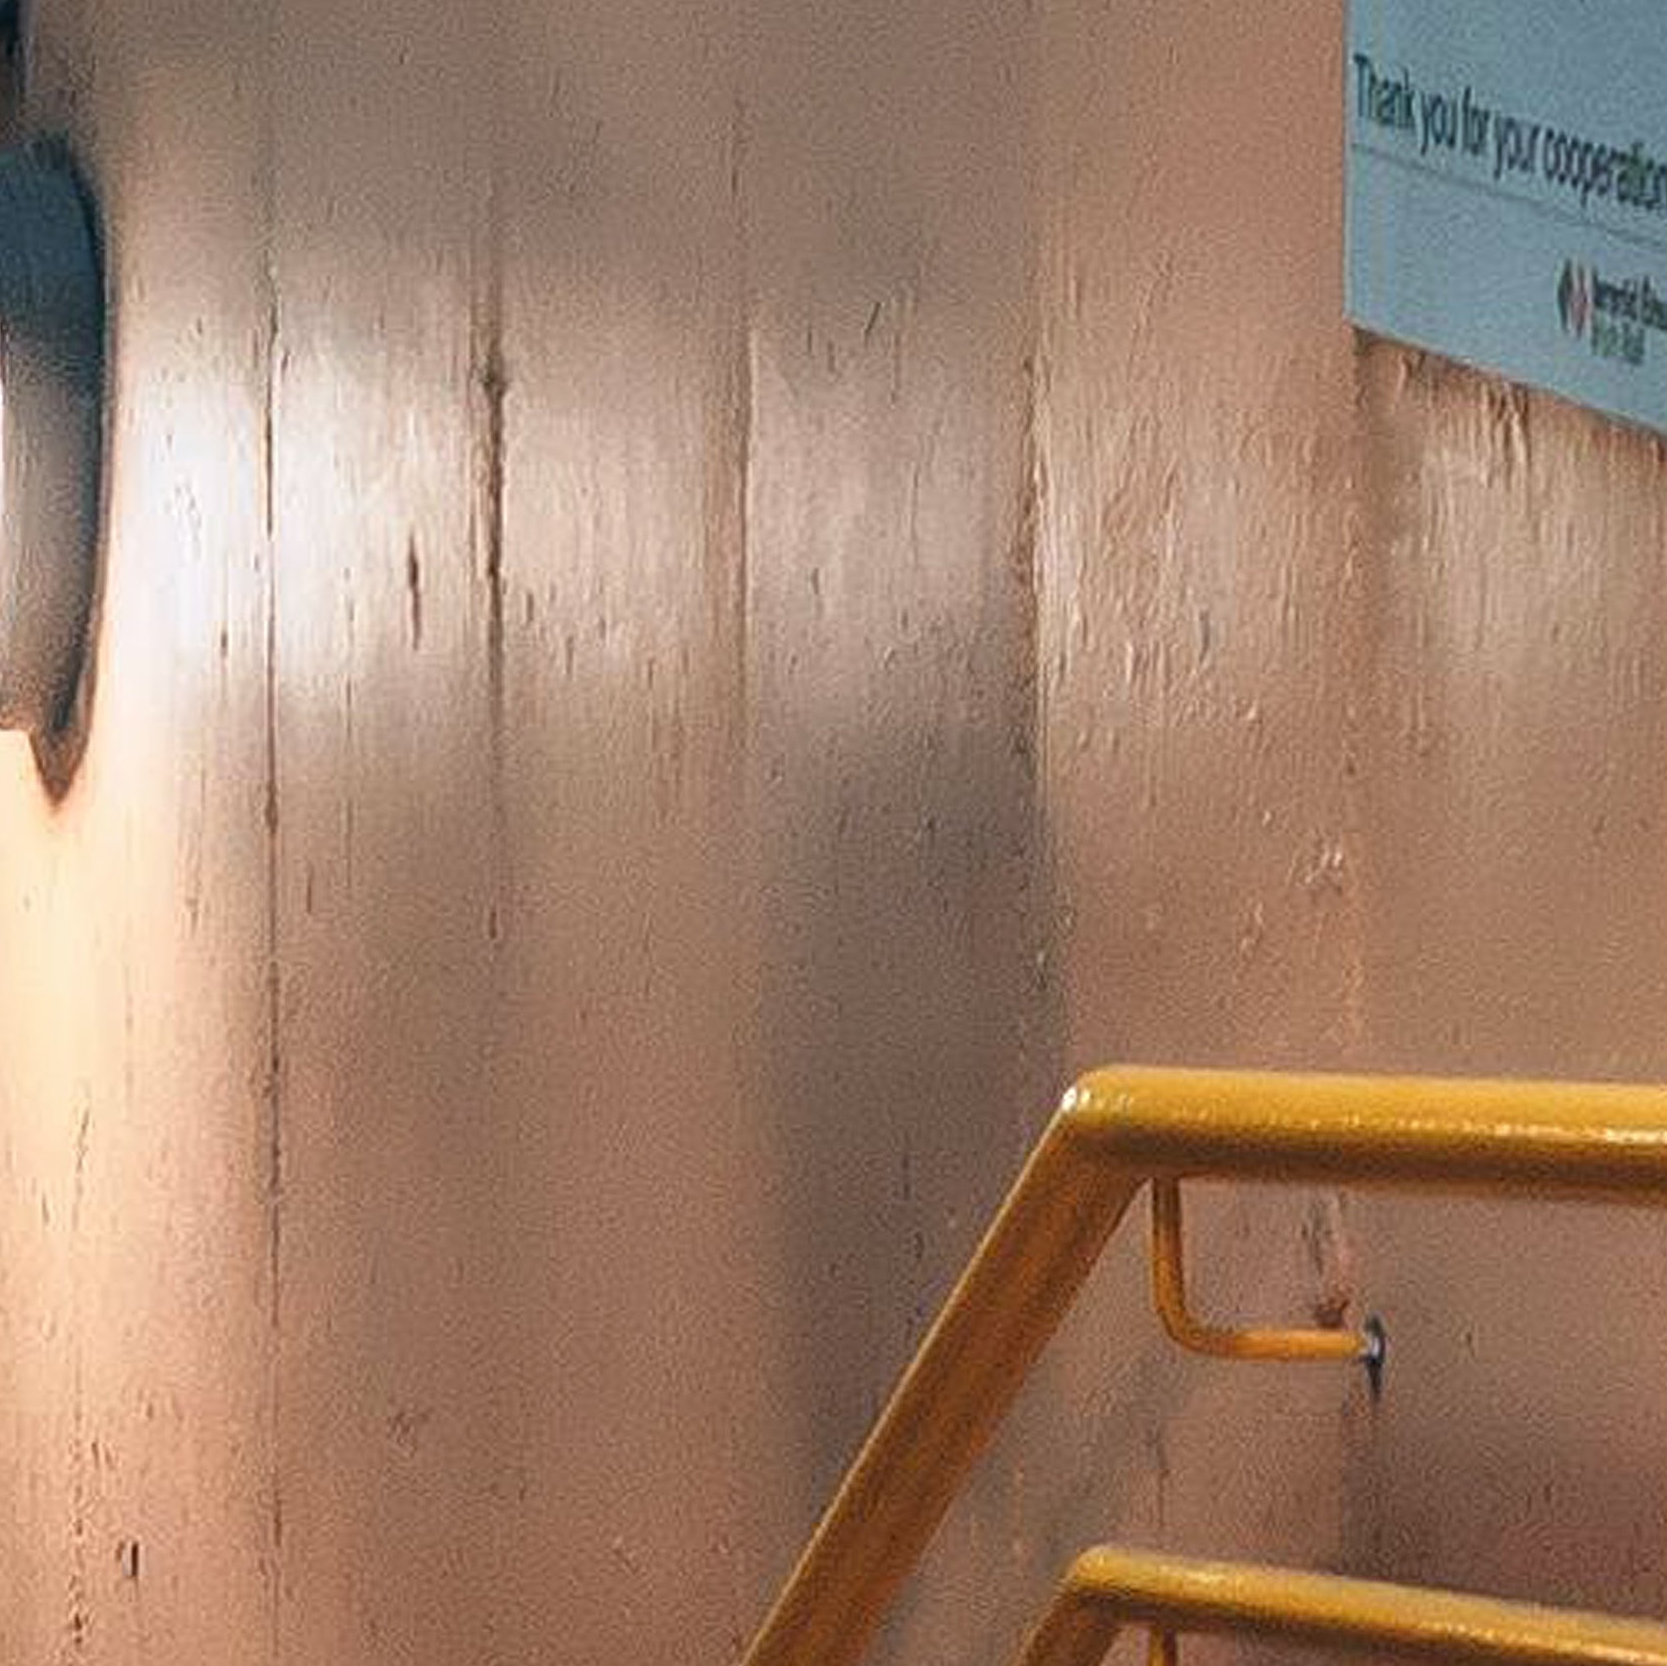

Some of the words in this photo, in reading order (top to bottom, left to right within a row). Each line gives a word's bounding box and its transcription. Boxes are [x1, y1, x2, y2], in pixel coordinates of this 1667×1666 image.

[1353, 54, 1416, 129] Thank
[1420, 91, 1458, 157] you
[1462, 85, 1491, 156] for
[1494, 115, 1541, 181] your
